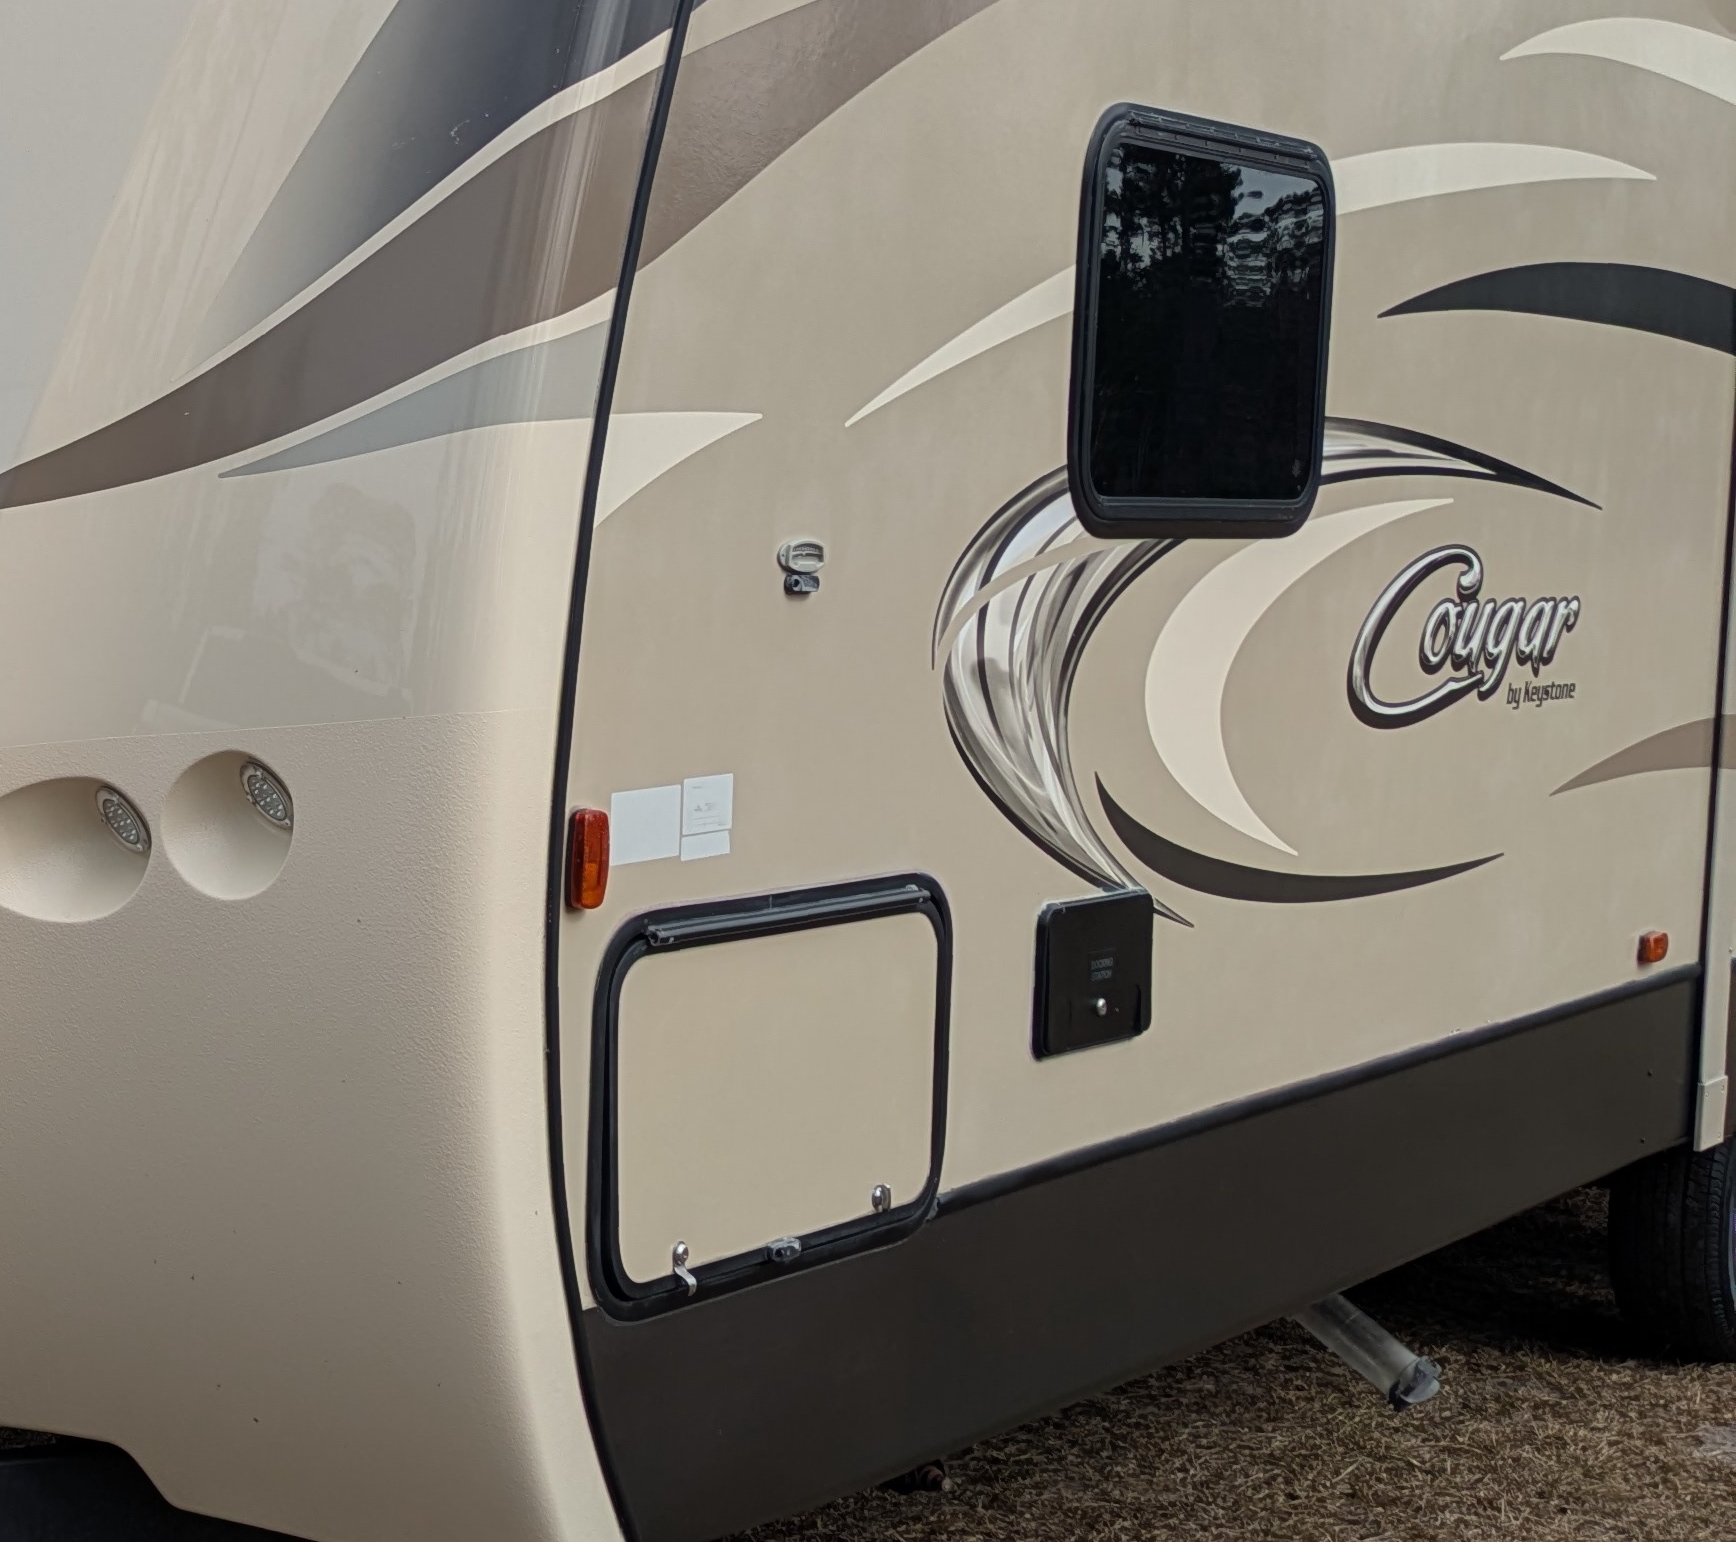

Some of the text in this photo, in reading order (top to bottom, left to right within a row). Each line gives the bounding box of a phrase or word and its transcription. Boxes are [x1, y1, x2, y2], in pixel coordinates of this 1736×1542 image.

[1347, 543, 1580, 730] Cougar
[1506, 681, 1576, 710] by Keystone
